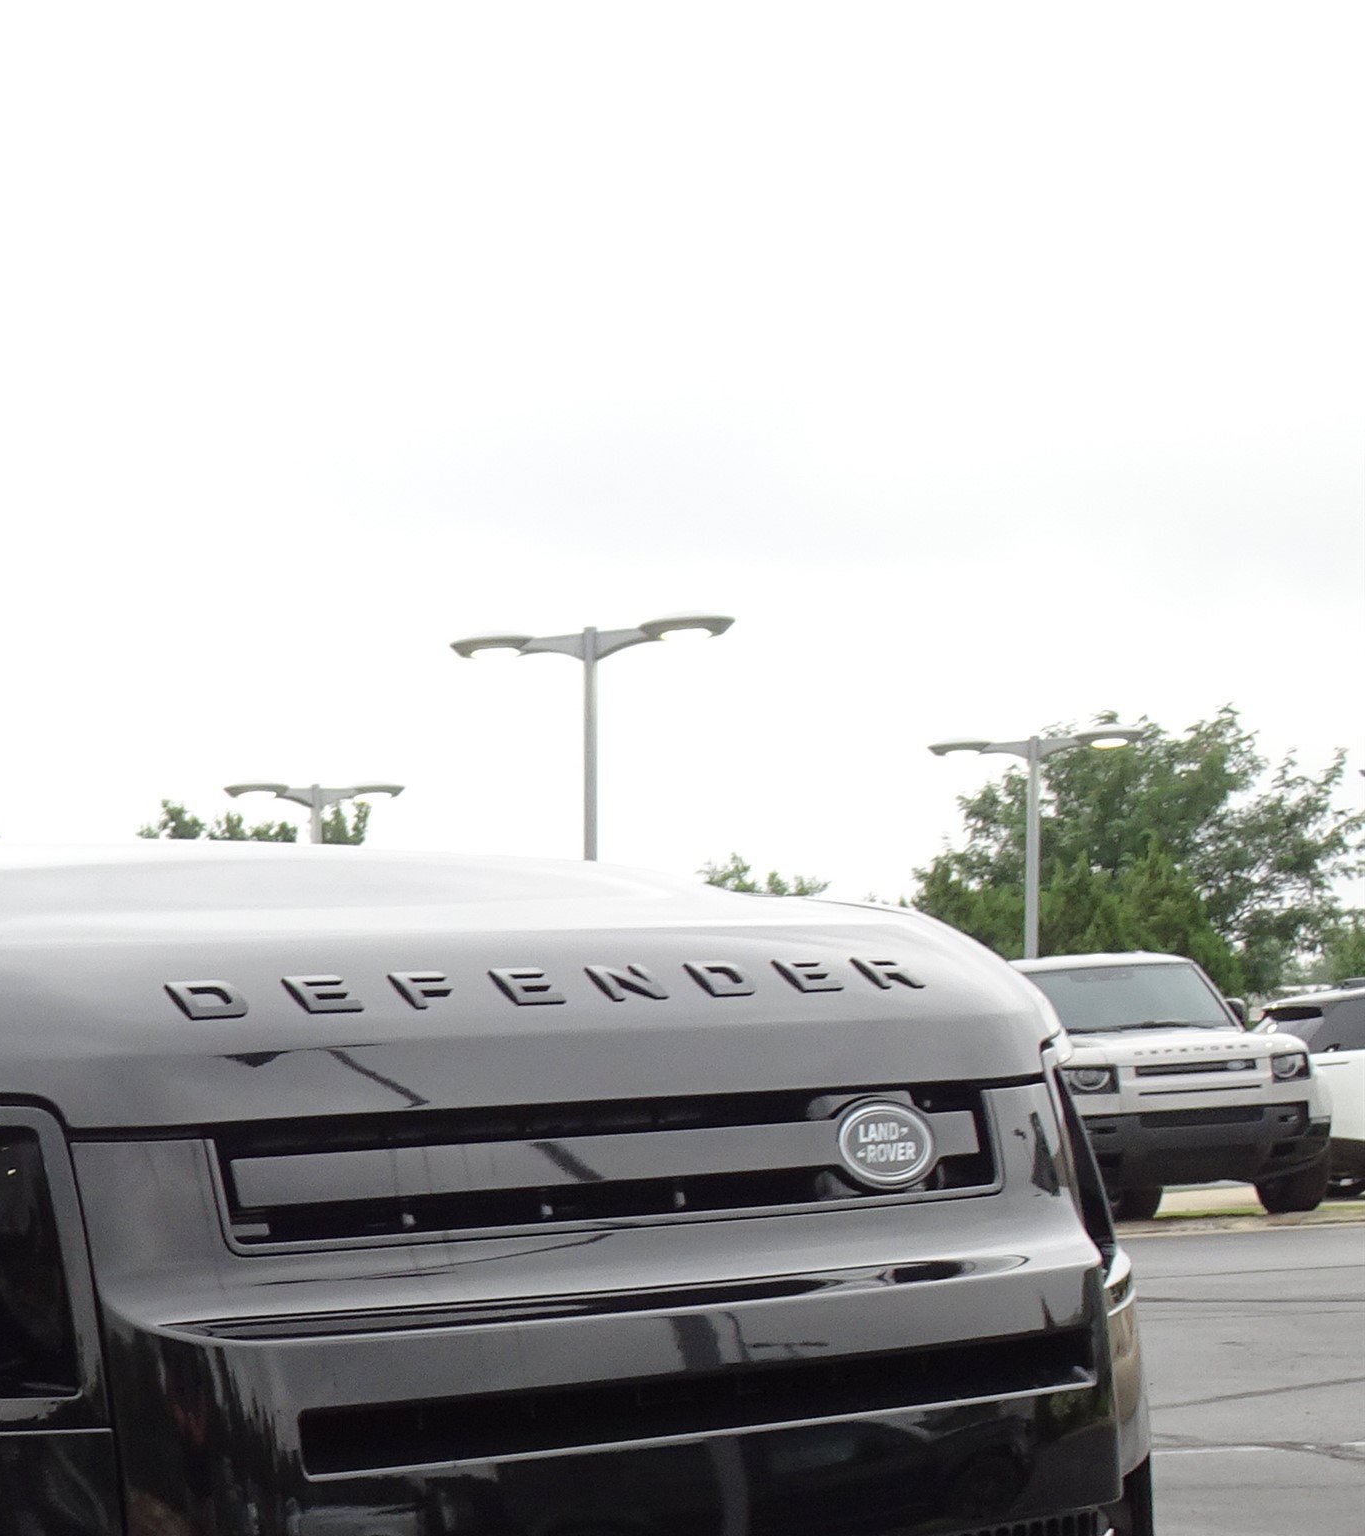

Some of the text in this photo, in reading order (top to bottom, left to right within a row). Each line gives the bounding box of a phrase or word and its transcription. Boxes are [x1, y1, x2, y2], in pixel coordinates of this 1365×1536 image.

[163, 956, 926, 1020] DEFENDER
[858, 1122, 899, 1143] LAND
[866, 1141, 916, 1163] ROVER
